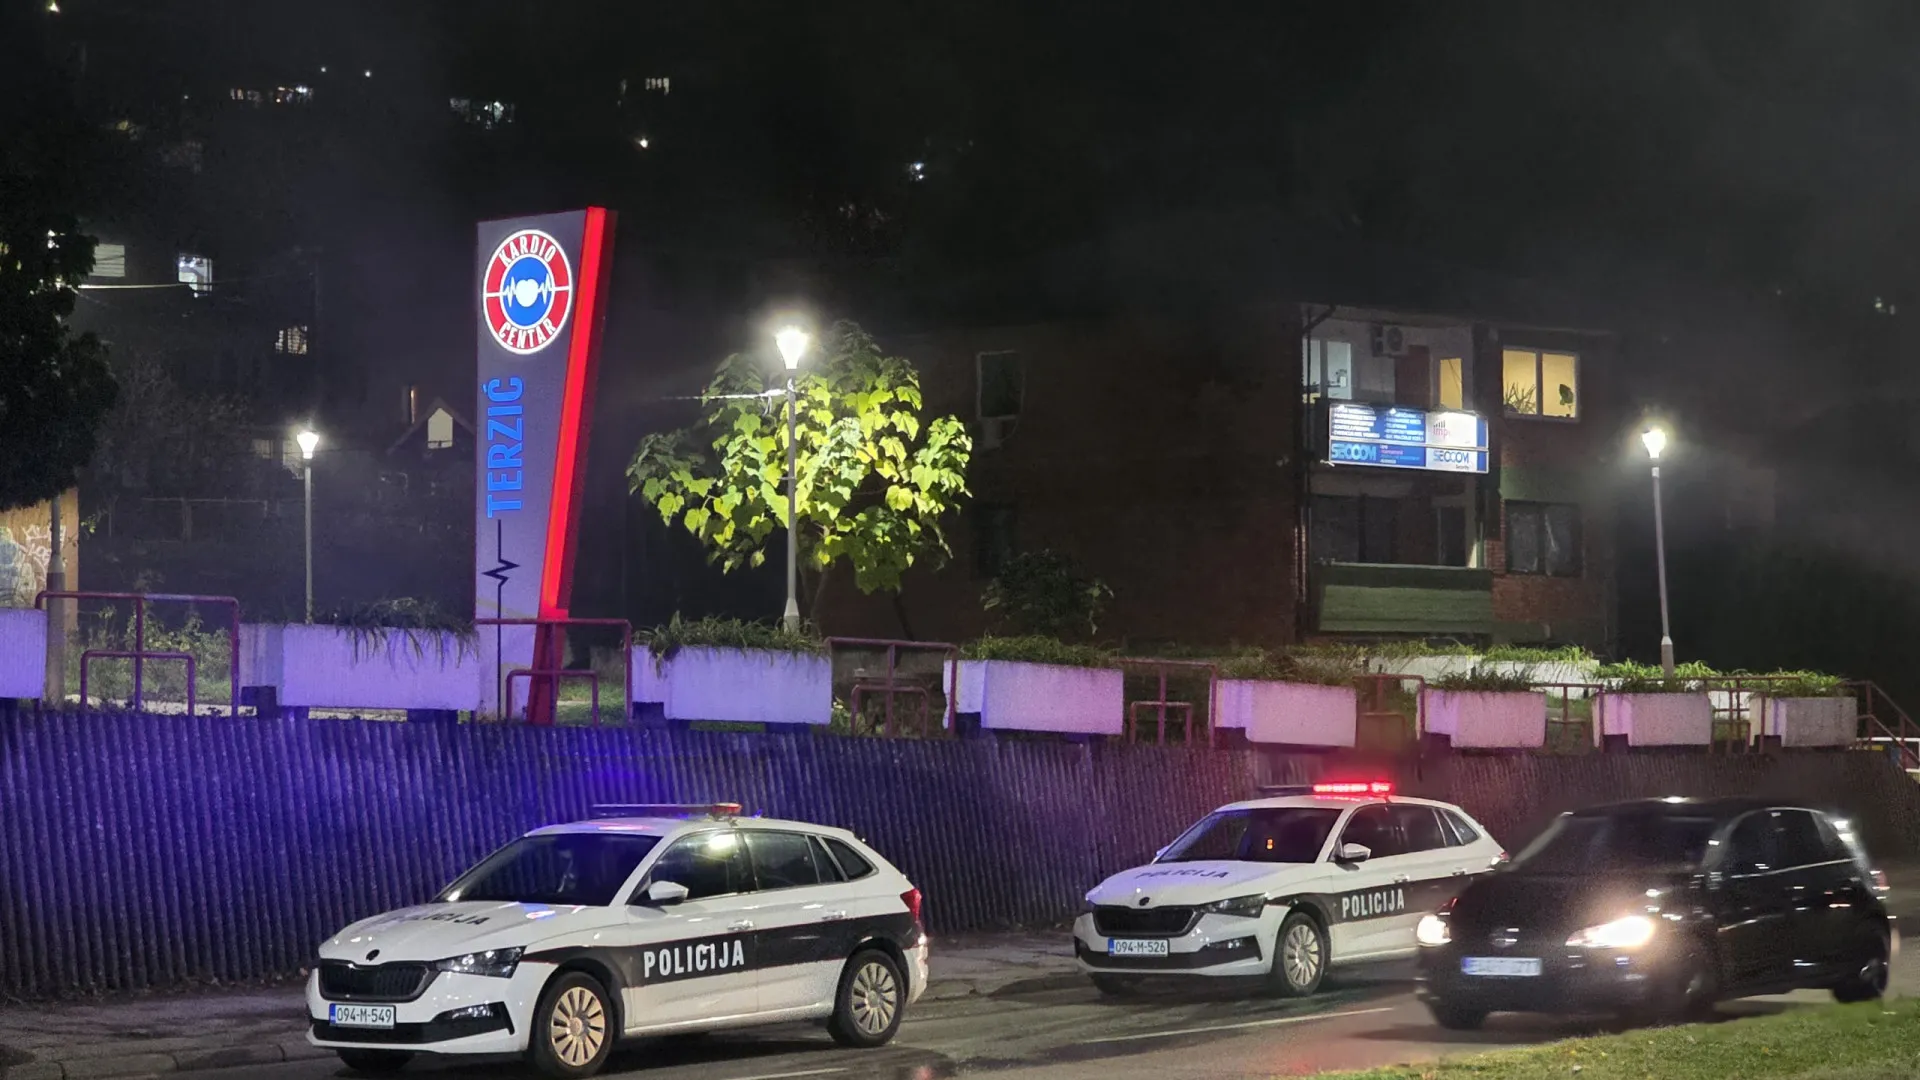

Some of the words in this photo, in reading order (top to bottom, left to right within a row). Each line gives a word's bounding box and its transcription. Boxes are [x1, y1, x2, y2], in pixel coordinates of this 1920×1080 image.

[499, 234, 557, 267] KARDIO
[498, 317, 556, 349] CENTAR
[482, 377, 523, 519] TERZIĆ
[1341, 888, 1405, 919] POLICIJA
[643, 939, 745, 978] POLICIJA
[1115, 941, 1166, 953] 094-M-526
[336, 1007, 392, 1023] 094-M-549
